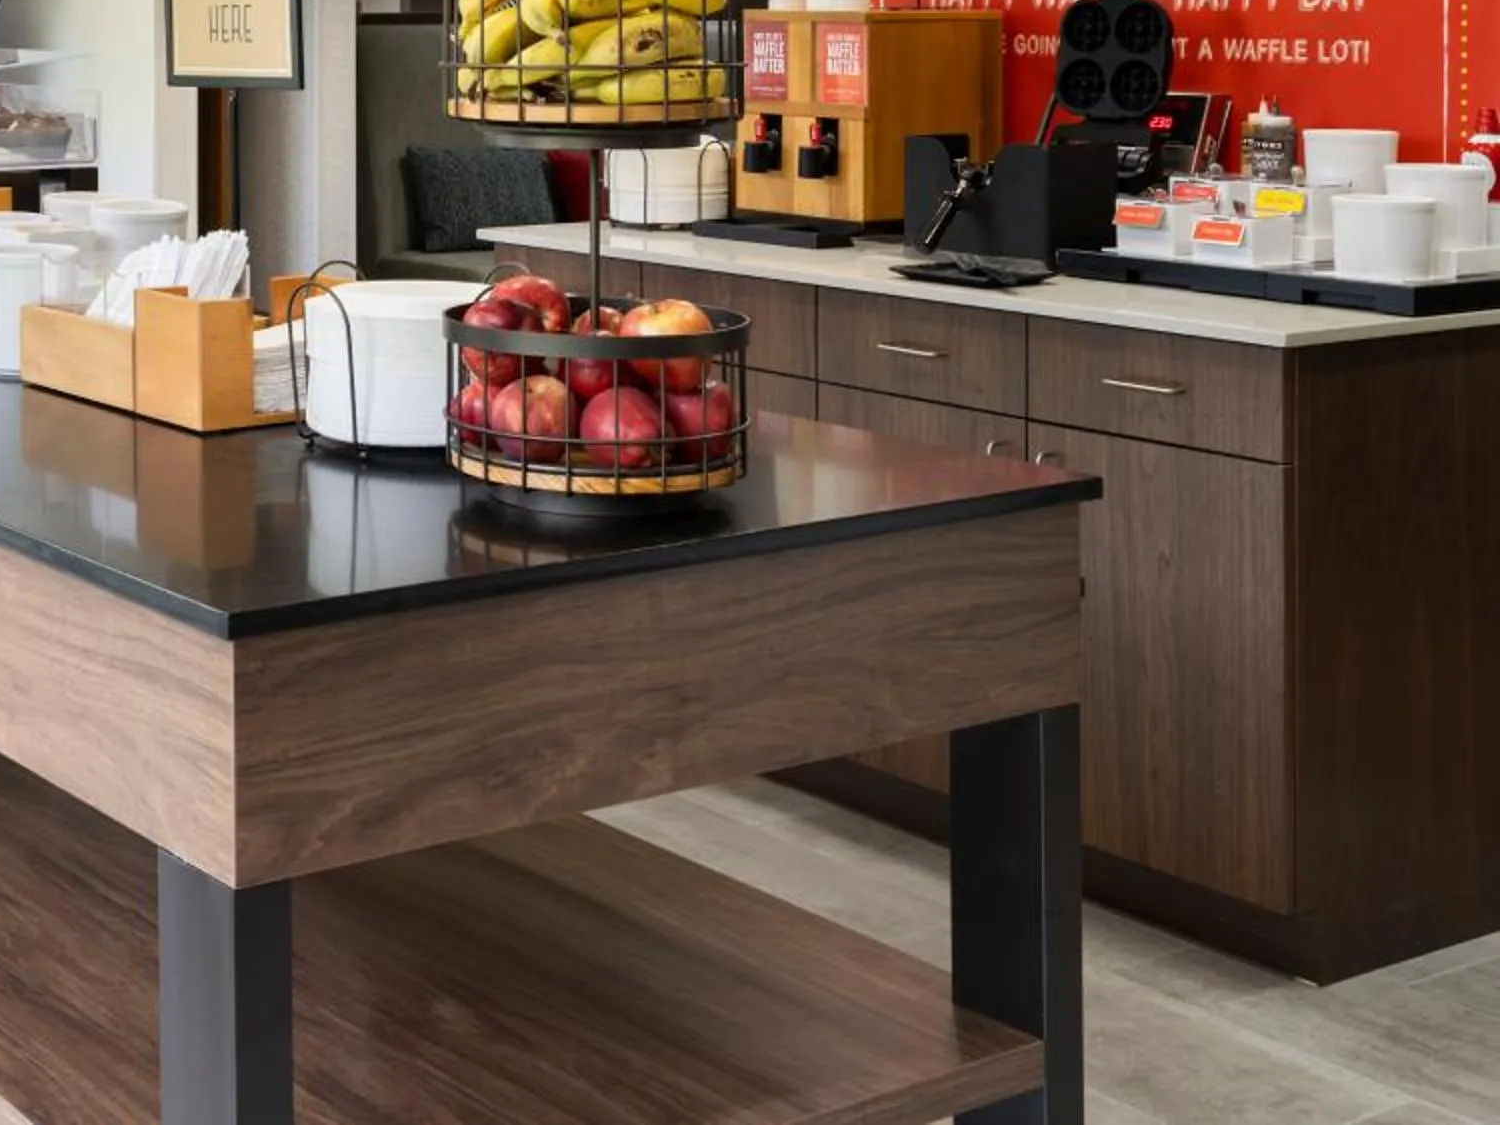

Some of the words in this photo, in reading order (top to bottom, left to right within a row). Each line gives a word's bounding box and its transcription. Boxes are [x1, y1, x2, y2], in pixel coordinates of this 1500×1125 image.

[209, 4, 253, 44] HERE
[753, 41, 785, 58] WAFFLE
[827, 42, 860, 59] WAFFLE
[1013, 34, 1060, 56] GOIN
[1197, 38, 1213, 61] A
[1223, 39, 1309, 62] WAFFLE
[1317, 39, 1370, 64] LOT!
[753, 57, 785, 74] BATTER
[827, 58, 860, 76] BATTER
